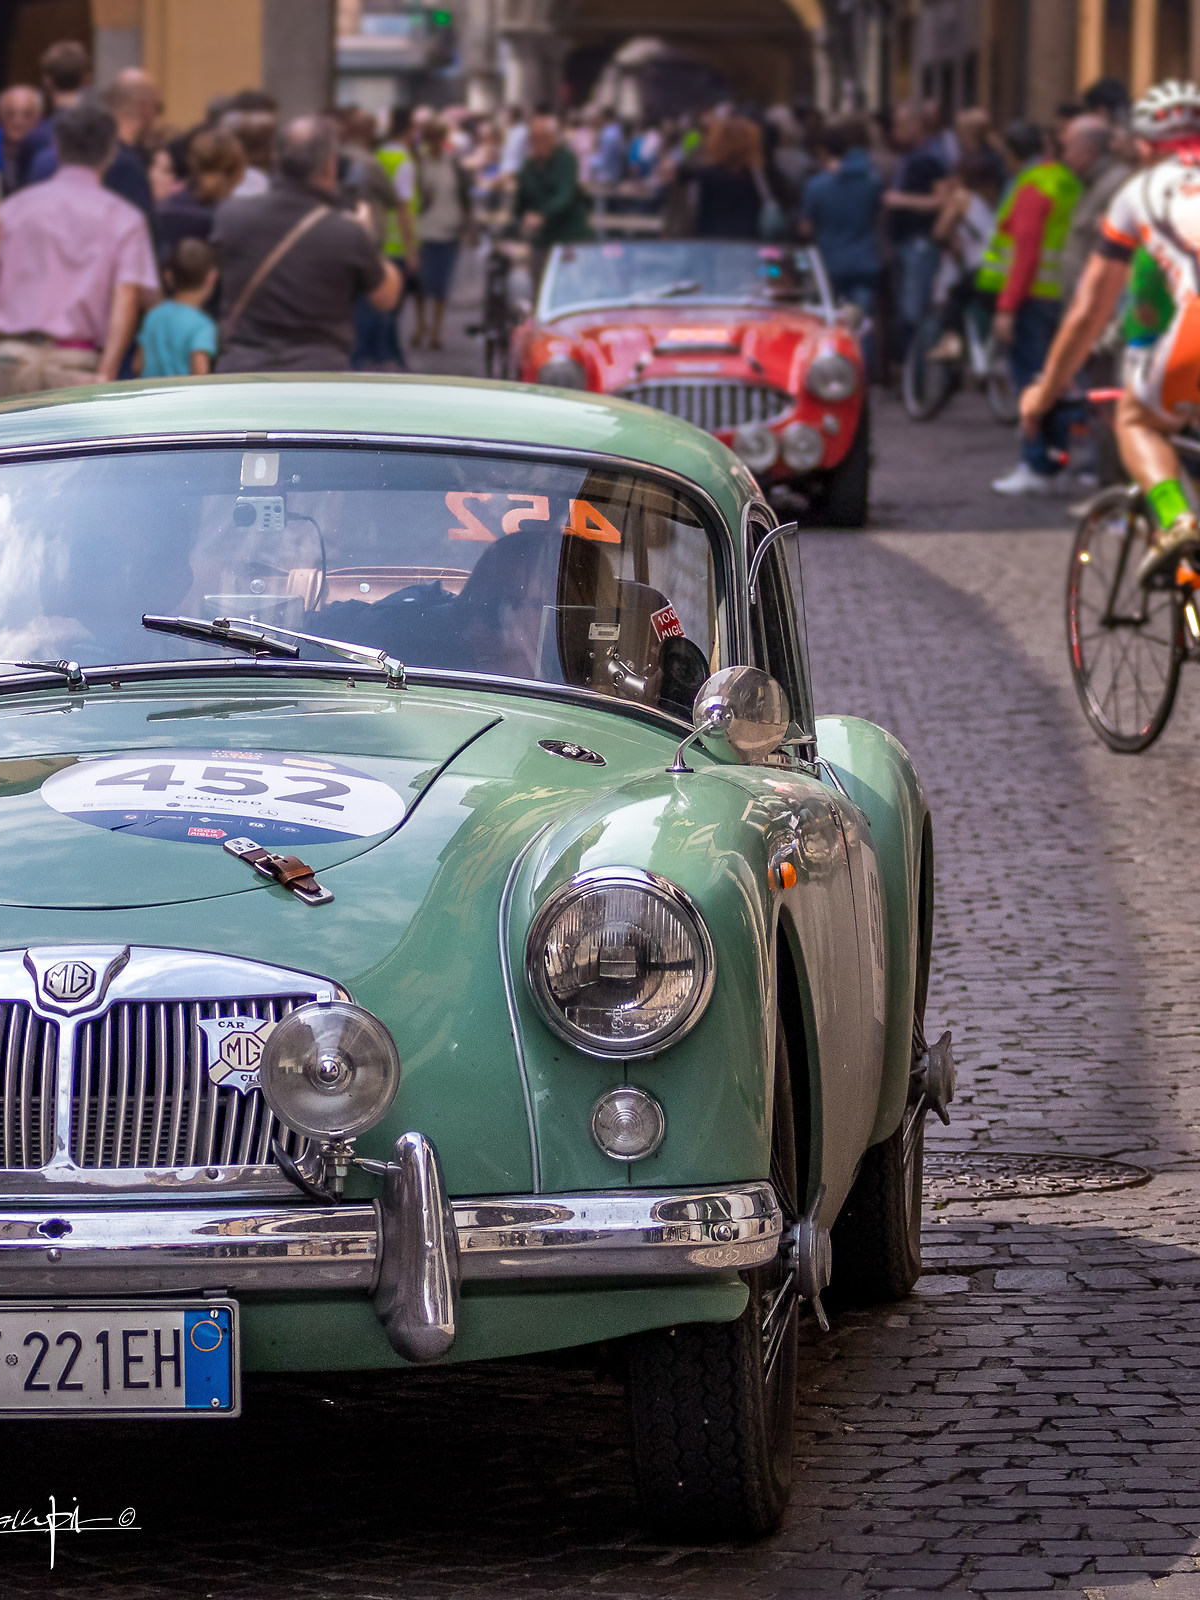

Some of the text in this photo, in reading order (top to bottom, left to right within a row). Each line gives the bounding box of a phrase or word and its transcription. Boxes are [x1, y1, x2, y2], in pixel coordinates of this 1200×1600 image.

[95, 764, 351, 812] 452
[175, 795, 262, 806] CHOPARD
[48, 963, 89, 994] MG
[217, 1021, 245, 1029] CAR
[226, 1037, 261, 1066] MG
